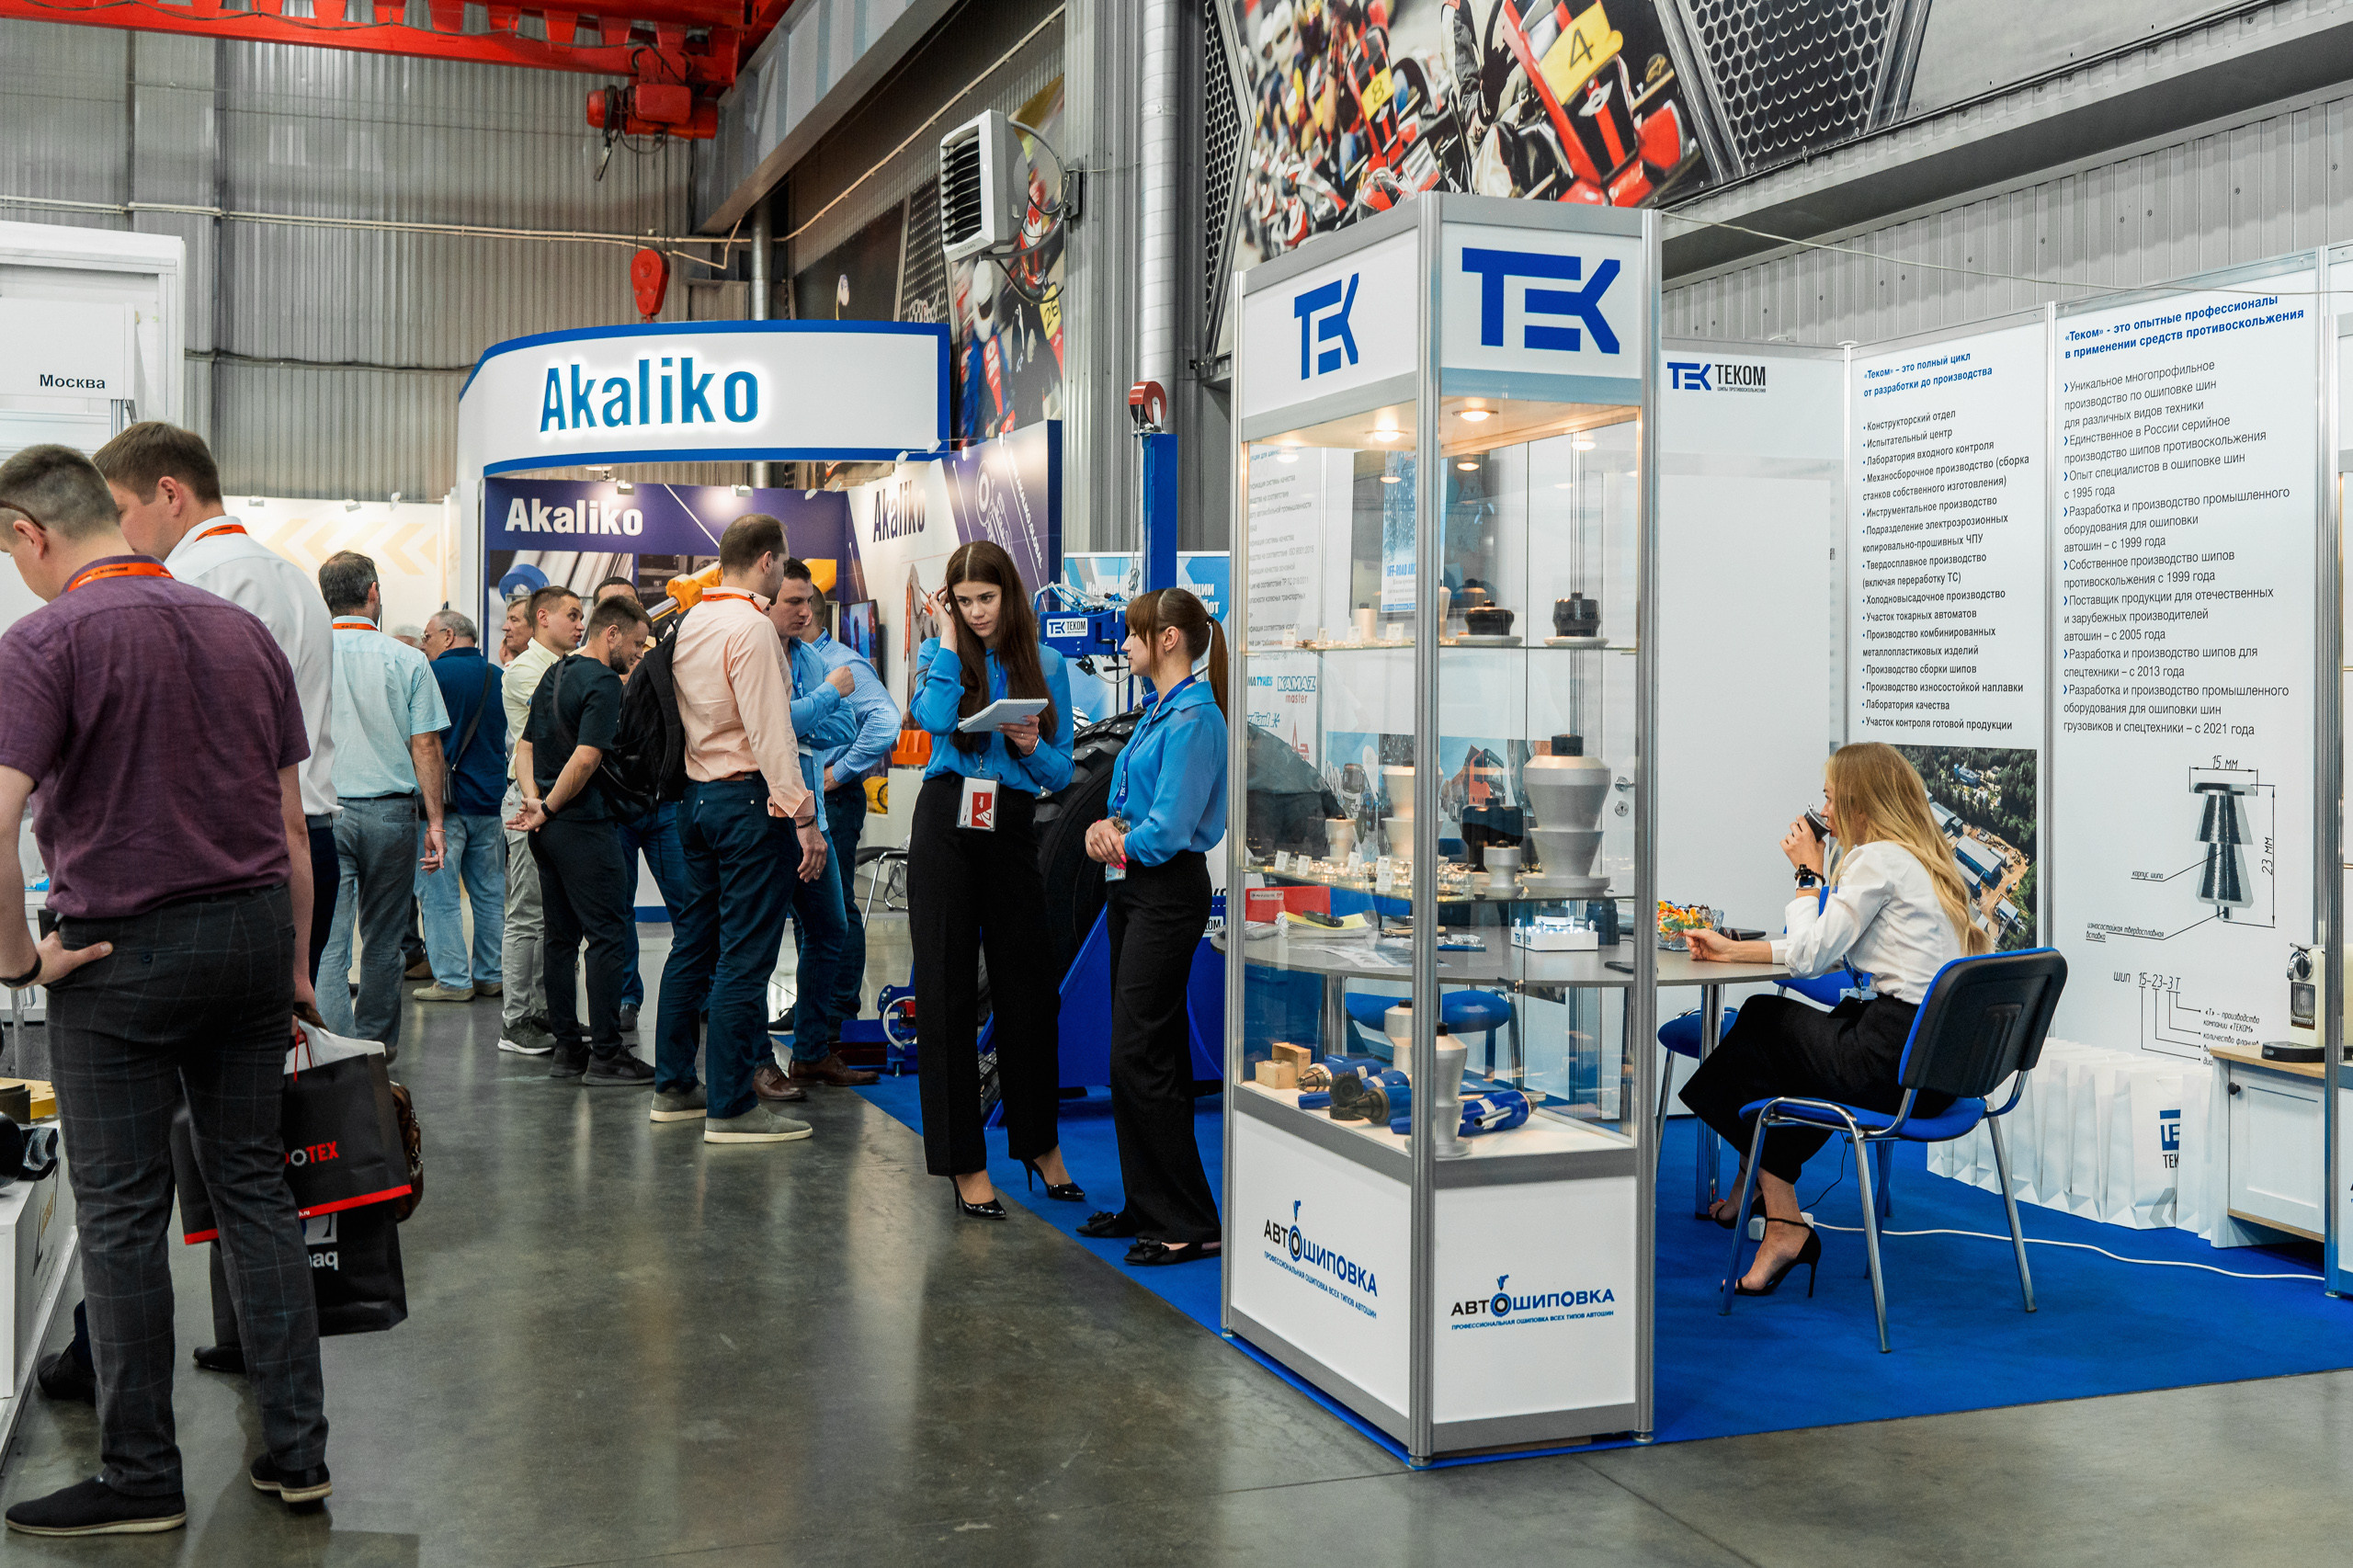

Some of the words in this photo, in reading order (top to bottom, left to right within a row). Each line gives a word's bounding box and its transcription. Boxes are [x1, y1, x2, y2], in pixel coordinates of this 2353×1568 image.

[1568, 29, 1594, 70] 4
[2064, 329, 2104, 342] «Теком»
[2113, 323, 2131, 334] это
[2133, 313, 2182, 330] опытные
[2185, 295, 2278, 322] профессионалы
[2064, 350, 2071, 359] в
[2074, 339, 2137, 359] применении
[2139, 331, 2183, 347] средств
[2186, 309, 2304, 340] противоскольжения
[1715, 364, 1767, 387] ТЕКОМ
[1864, 369, 1893, 379] «Теком»
[1902, 364, 1915, 373] это
[1916, 355, 1949, 370] полный
[1950, 353, 1971, 365] цикл
[2069, 376, 2123, 392] Уникальное
[2125, 361, 2215, 383] многопрофильное
[40, 373, 107, 390] Москва
[1863, 389, 1872, 397] от
[1874, 381, 1919, 397] разработки
[1920, 378, 1931, 389] до
[1933, 367, 1993, 386] производства
[540, 357, 758, 434] Akaliko
[2064, 393, 2128, 413] производство
[2130, 391, 2143, 401] по
[2143, 383, 2193, 399] ошиповке
[2195, 380, 2217, 392] шин
[1867, 412, 1931, 431] Конструкторский
[1932, 410, 1956, 421] отдел
[2063, 418, 2080, 431] для
[2082, 411, 2131, 428] различных
[2133, 406, 2163, 420] видов
[2165, 401, 2204, 415] техники
[1867, 430, 1927, 449] Испытательный
[1929, 428, 1953, 440] центр
[2069, 429, 2133, 447] Единственное
[2135, 428, 2142, 437] в
[2143, 423, 2179, 436] России
[2181, 415, 2231, 433] серийное
[1867, 452, 1915, 466] Лаборатория
[1916, 447, 1954, 460] входного
[1955, 441, 1995, 454] контроля
[2063, 448, 2128, 466] производство
[2129, 444, 2161, 456] шипов
[2163, 431, 2267, 454] противоскольжения
[1867, 468, 1934, 483] Механосборочное
[1936, 460, 1995, 476] производство
[1995, 455, 2029, 470] (сборка
[1862, 491, 1891, 501] станков
[1893, 484, 1946, 497] собственного
[1947, 474, 2007, 492] изготовления)
[872, 480, 926, 543] Akaliko
[1867, 503, 1938, 518] Инструментальное
[1938, 496, 1997, 513] производство
[2069, 503, 2121, 518] Разработка
[2123, 503, 2130, 512] и
[2131, 496, 2200, 514] производство
[2202, 488, 2290, 507] промышленного
[505, 497, 643, 537] Akaliko
[1866, 522, 1924, 537] Подразделение
[1925, 515, 2008, 530] электроэрозионных
[2063, 521, 2128, 537] оборудования
[2129, 519, 2147, 532] для
[2149, 514, 2199, 528] ошиповки
[1862, 537, 1964, 554] копировально-прошивных
[1965, 533, 1984, 544] ЧПУ
[1866, 558, 1927, 572] Твердосплавное
[1929, 553, 1987, 568] производство
[2069, 558, 2129, 571] Собственное
[2131, 553, 2199, 569] производство
[2201, 551, 2235, 562] шипов
[1866, 593, 1945, 606] Холодновысадочное
[1946, 590, 2006, 603] производство
[2069, 595, 2120, 607] Поставщик
[2121, 593, 2172, 607] продукции
[2175, 591, 2192, 603] для
[2195, 588, 2274, 602] отечественных
[1066, 621, 1086, 631] ТЕКОМ
[1866, 612, 1894, 622] Участок
[1895, 611, 1933, 622] токарных
[1934, 609, 1977, 619] автоматов
[1866, 630, 1918, 642] Производство
[1920, 627, 1996, 640] комбинированных
[1862, 648, 1942, 657] металлопластиковых
[1944, 644, 1979, 657] изделий
[1866, 664, 1918, 676] Производство
[1919, 663, 1948, 676] сборки
[1949, 665, 1977, 674] шипов
[1277, 676, 1316, 692] KAMAZ
[1866, 681, 1918, 694] Производство
[1919, 681, 1980, 692] износостойкой
[1982, 684, 2024, 692] наплавки
[1285, 693, 1308, 704] master
[1865, 699, 1914, 711] Лаборатория
[1915, 701, 1949, 710] качества
[1865, 716, 1894, 727] Участок
[1895, 719, 1931, 730] контроля
[1932, 718, 1964, 729] готовой
[1966, 721, 2013, 733] продукции
[2212, 755, 2222, 769] 15
[2262, 858, 2273, 876] 23
[309, 1250, 338, 1271] aq
[1264, 1219, 1378, 1298] АВТОШИПОВКА
[1264, 1250, 1305, 1279] ПРОФЕССИОНАЛЬНАЯ
[1305, 1273, 1328, 1292] ОШИПОВКА
[1329, 1286, 1340, 1299] ВСЕХ
[1340, 1292, 1355, 1307] ТИПОВ
[1355, 1301, 1377, 1320] АВТОШИН
[1450, 1289, 1615, 1318] АВТОШИПОВКА
[1451, 1320, 1516, 1331] ПРОФЕССИОНАЛЬНАЯ
[1517, 1316, 1550, 1324] ОШИПОВКА
[1566, 1312, 1586, 1321] ТИПОВ
[1586, 1311, 1614, 1319] АВТОШИН
